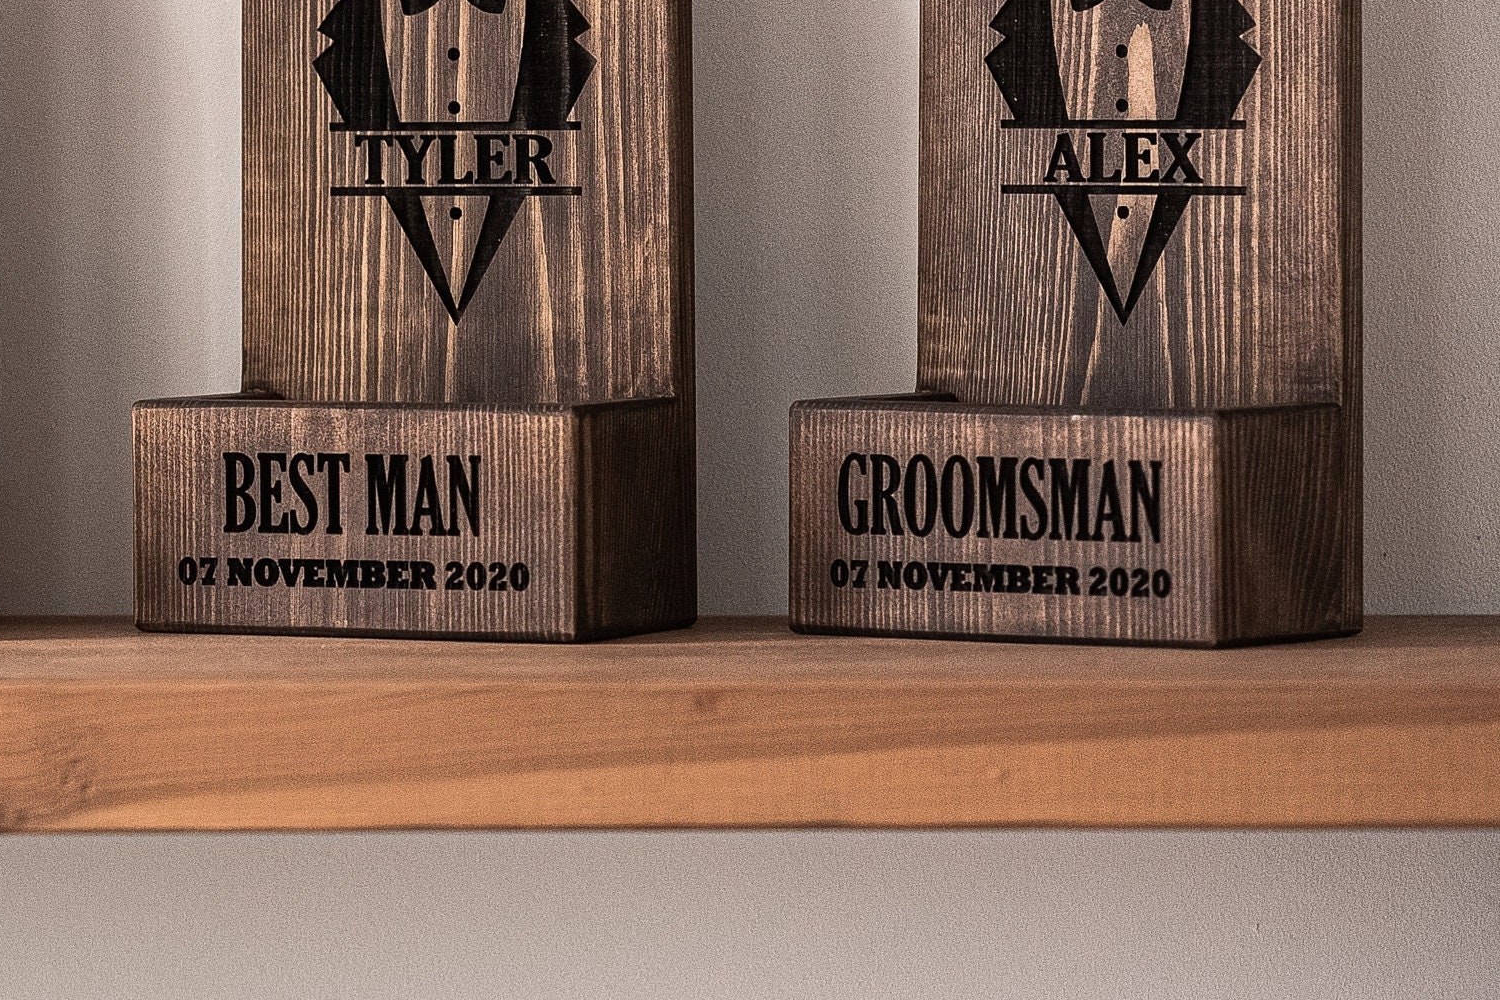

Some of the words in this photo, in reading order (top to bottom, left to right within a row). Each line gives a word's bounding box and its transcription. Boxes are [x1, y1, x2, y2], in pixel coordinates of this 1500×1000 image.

[354, 134, 557, 185] TYLER
[1043, 132, 1204, 183] ALEX
[222, 451, 351, 535] BEST
[365, 453, 482, 537] MAN
[837, 452, 1163, 543] GROOMSMAN
[178, 556, 219, 586] 07
[227, 557, 437, 591] NOVEMBER
[445, 561, 530, 592] 2020
[830, 559, 869, 589] 07
[877, 560, 1081, 597] NOVEMBER
[1088, 565, 1173, 599] 2020
